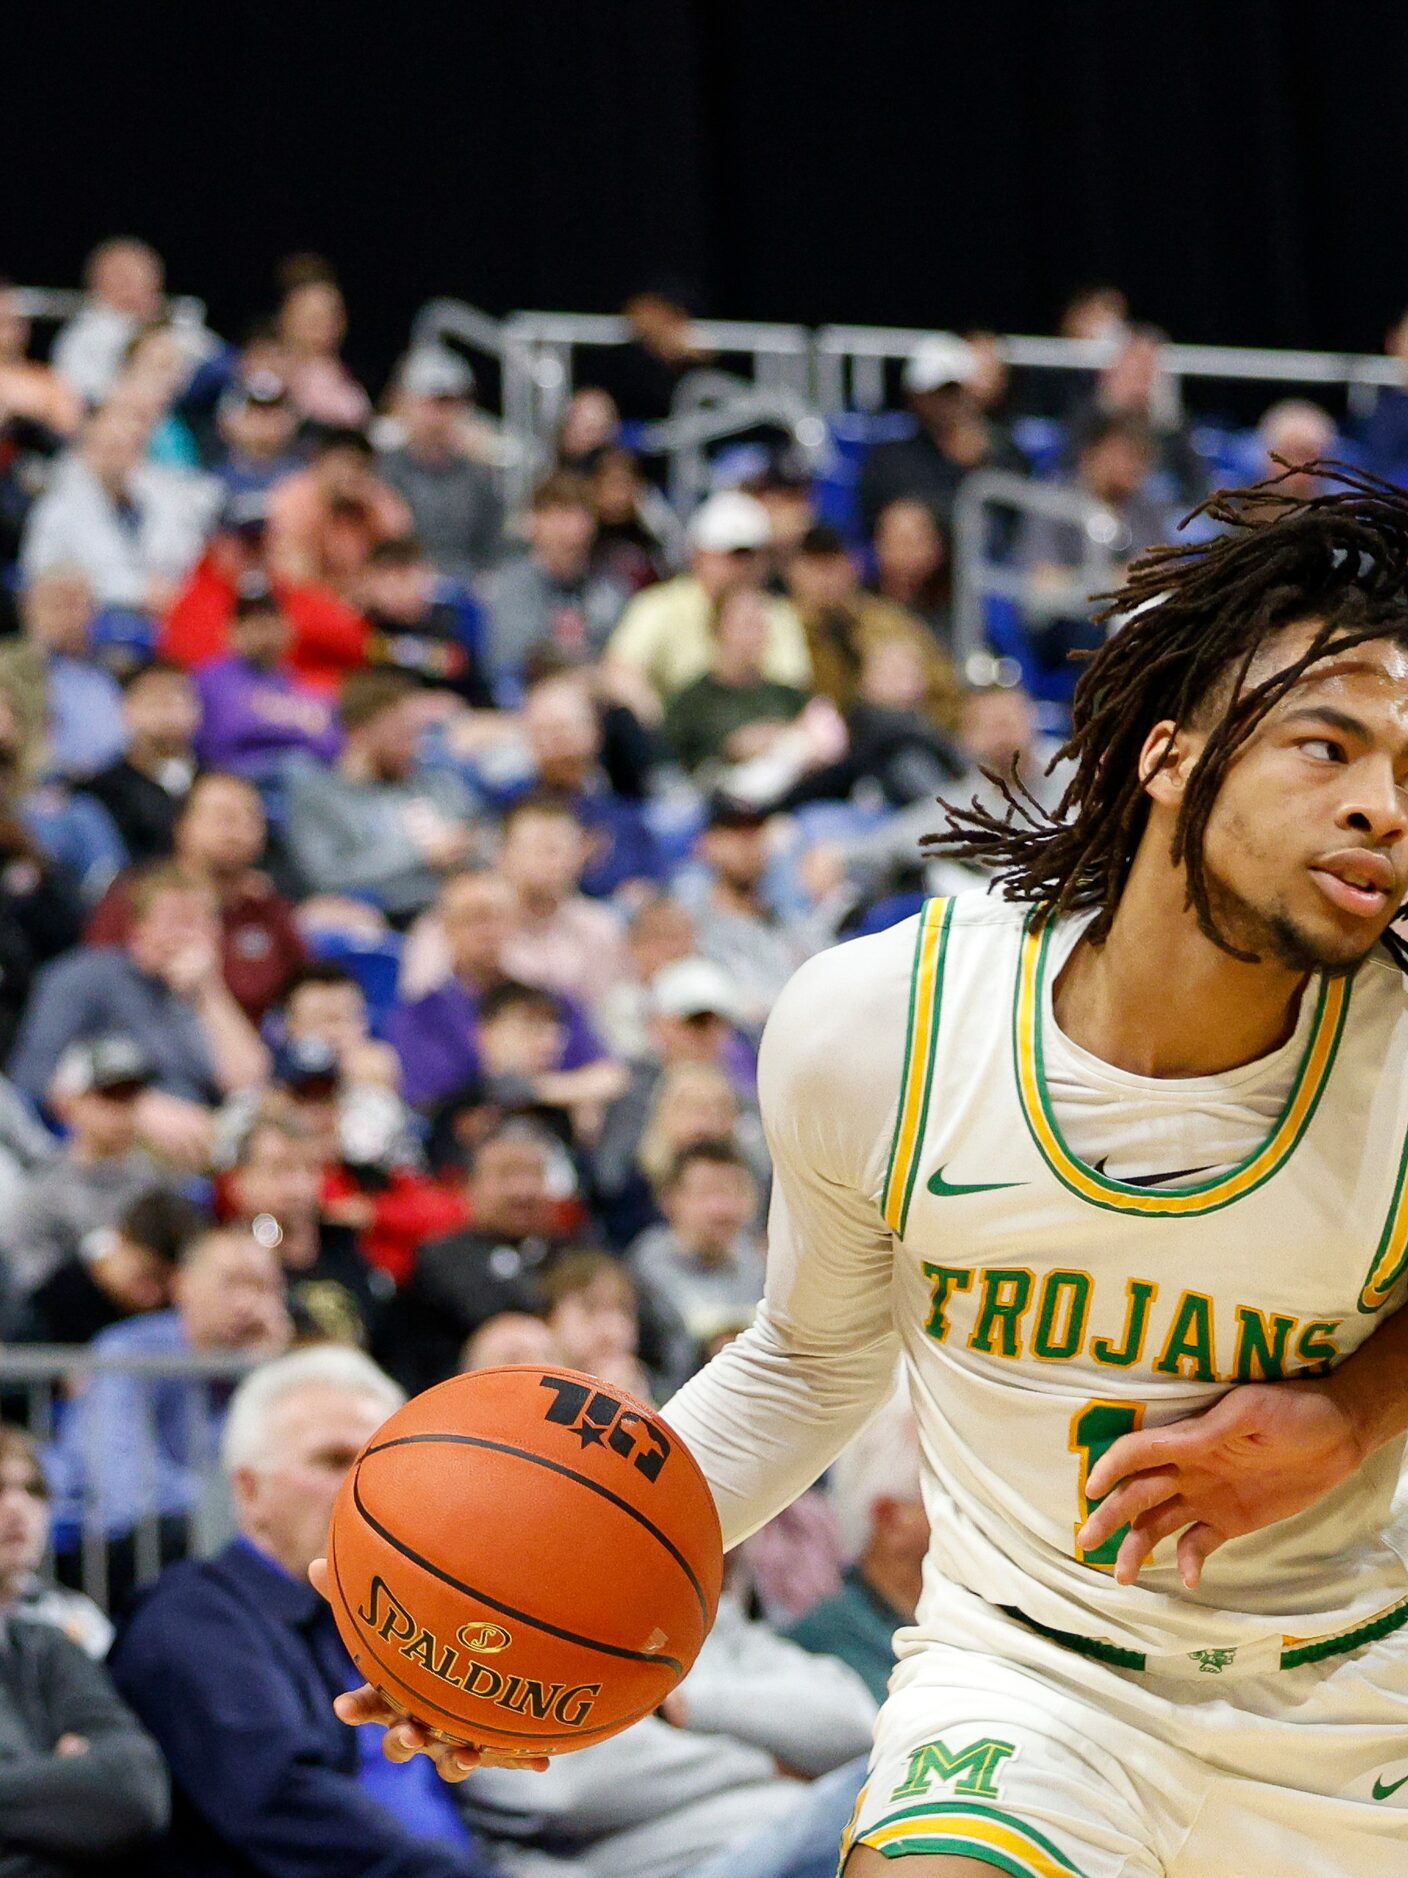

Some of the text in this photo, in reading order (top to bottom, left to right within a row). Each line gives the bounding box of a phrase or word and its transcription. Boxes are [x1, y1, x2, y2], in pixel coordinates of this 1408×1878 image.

[921, 1260, 1345, 1384] TROJANS
[357, 1575, 602, 1728] SPALDING
[890, 1738, 1016, 1803] M
